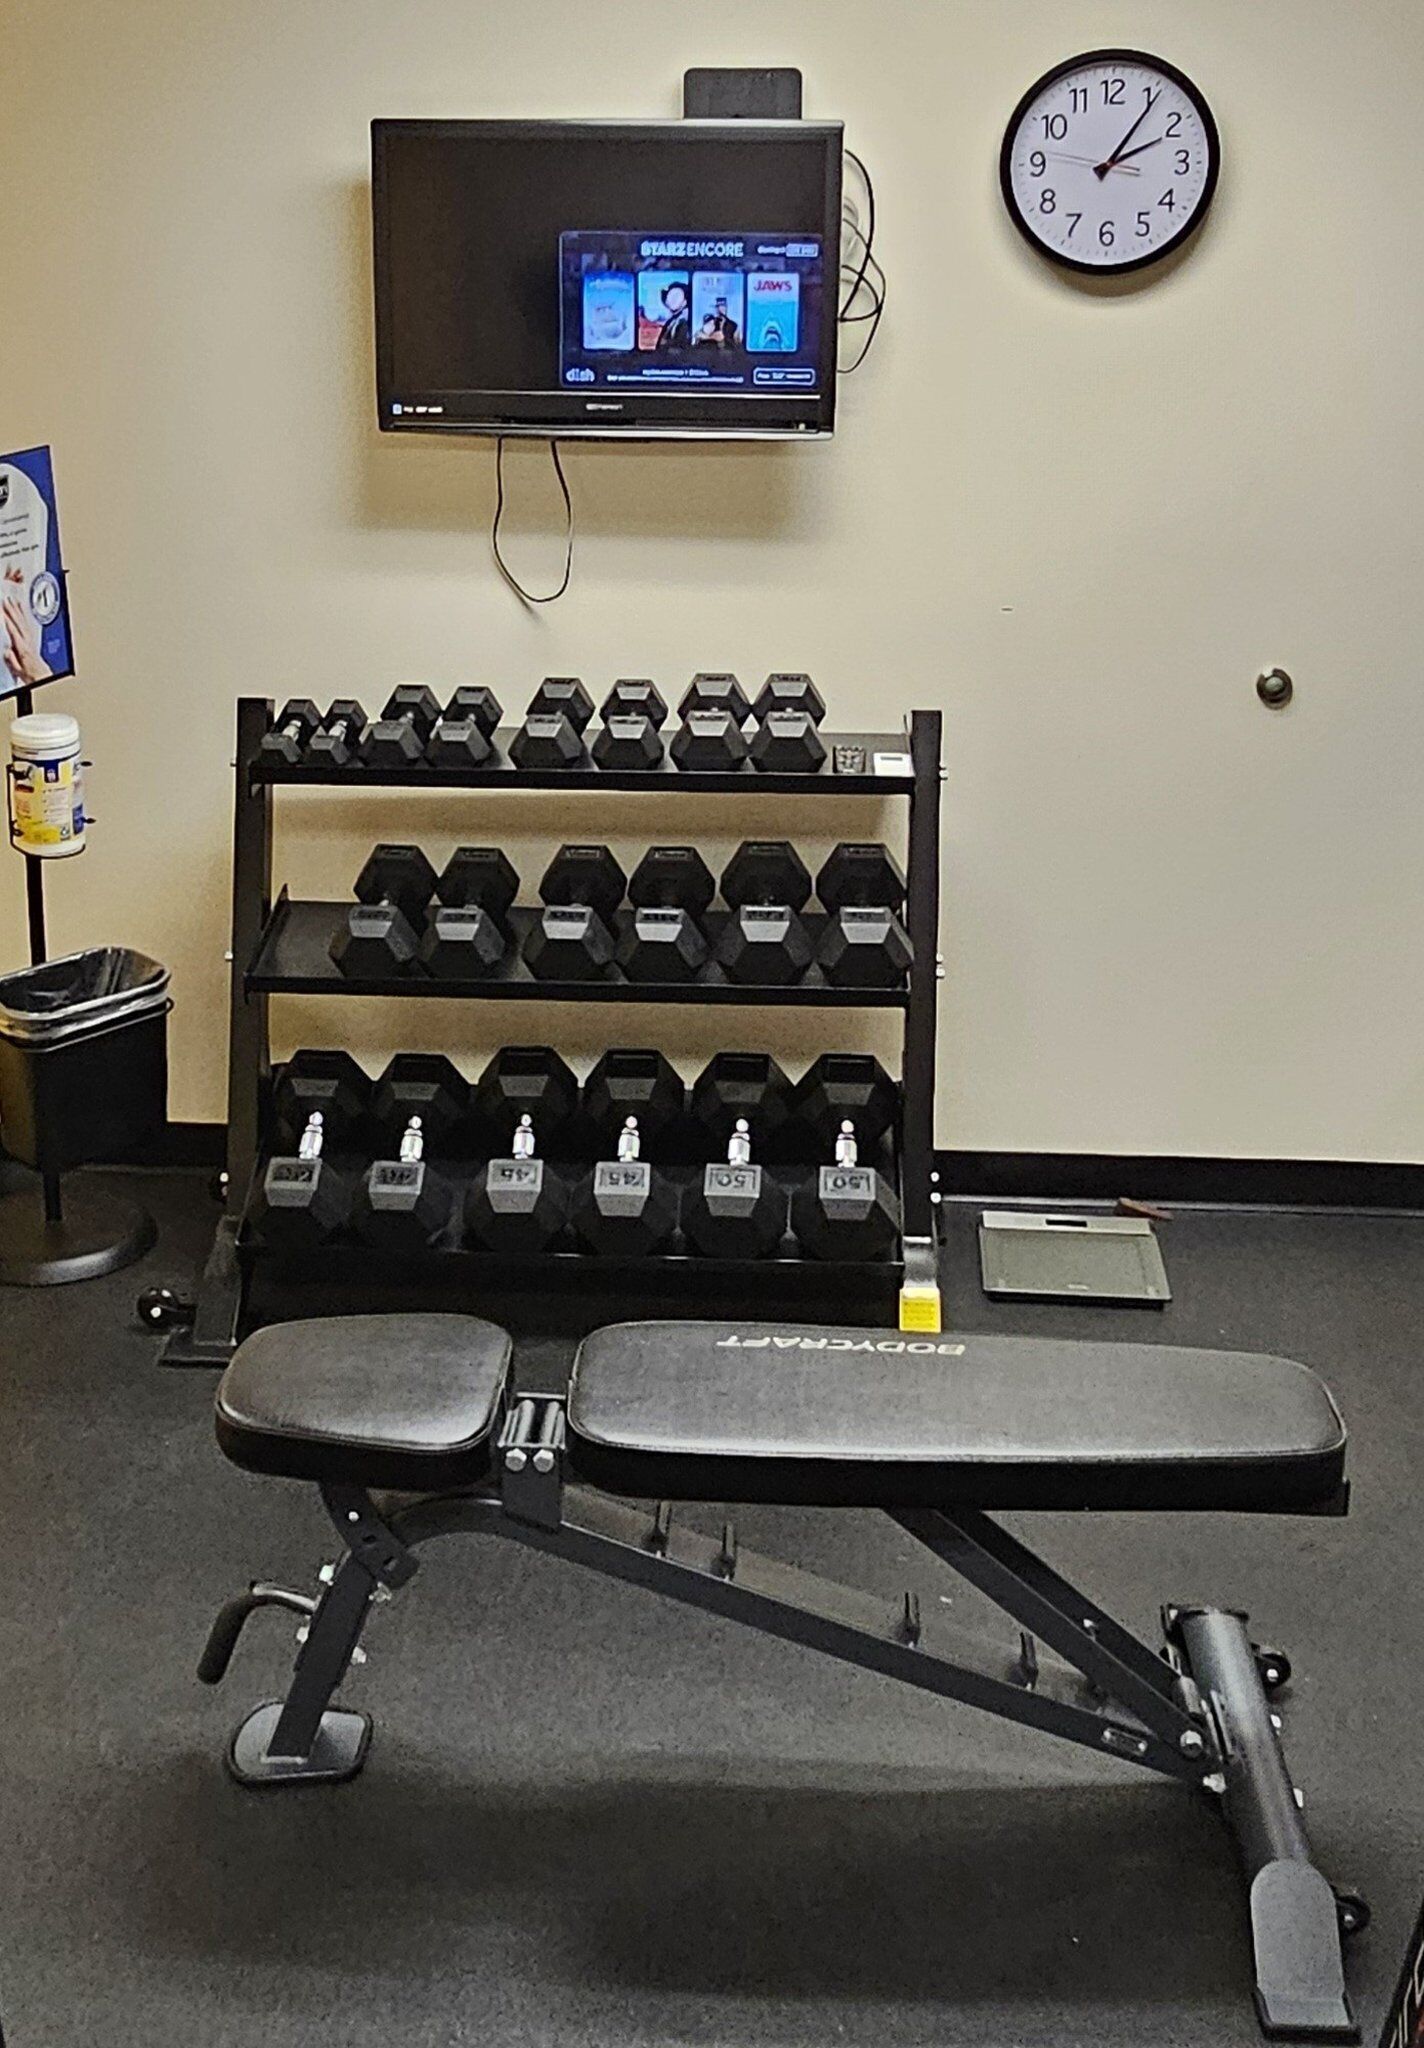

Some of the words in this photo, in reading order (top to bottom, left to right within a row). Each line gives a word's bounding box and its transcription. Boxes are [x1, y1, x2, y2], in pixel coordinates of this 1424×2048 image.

[1068, 87, 1088, 113] 11
[1101, 78, 1126, 105] 12
[1041, 113, 1068, 140] 10
[1165, 111, 1183, 138] 2
[1029, 151, 1047, 177] 9
[1174, 150, 1190, 175] 3
[1039, 188, 1056, 214] 8
[1157, 188, 1176, 212] 4
[1065, 213, 1083, 238] 7
[1099, 220, 1115, 247] 6
[1135, 211, 1151, 237] 5
[753, 279, 793, 292] JAWS
[565, 367, 596, 383] dish
[717, 1173, 747, 1189] 50
[832, 1174, 862, 1191] 50
[716, 1335, 966, 1356] BODYCRAFT
